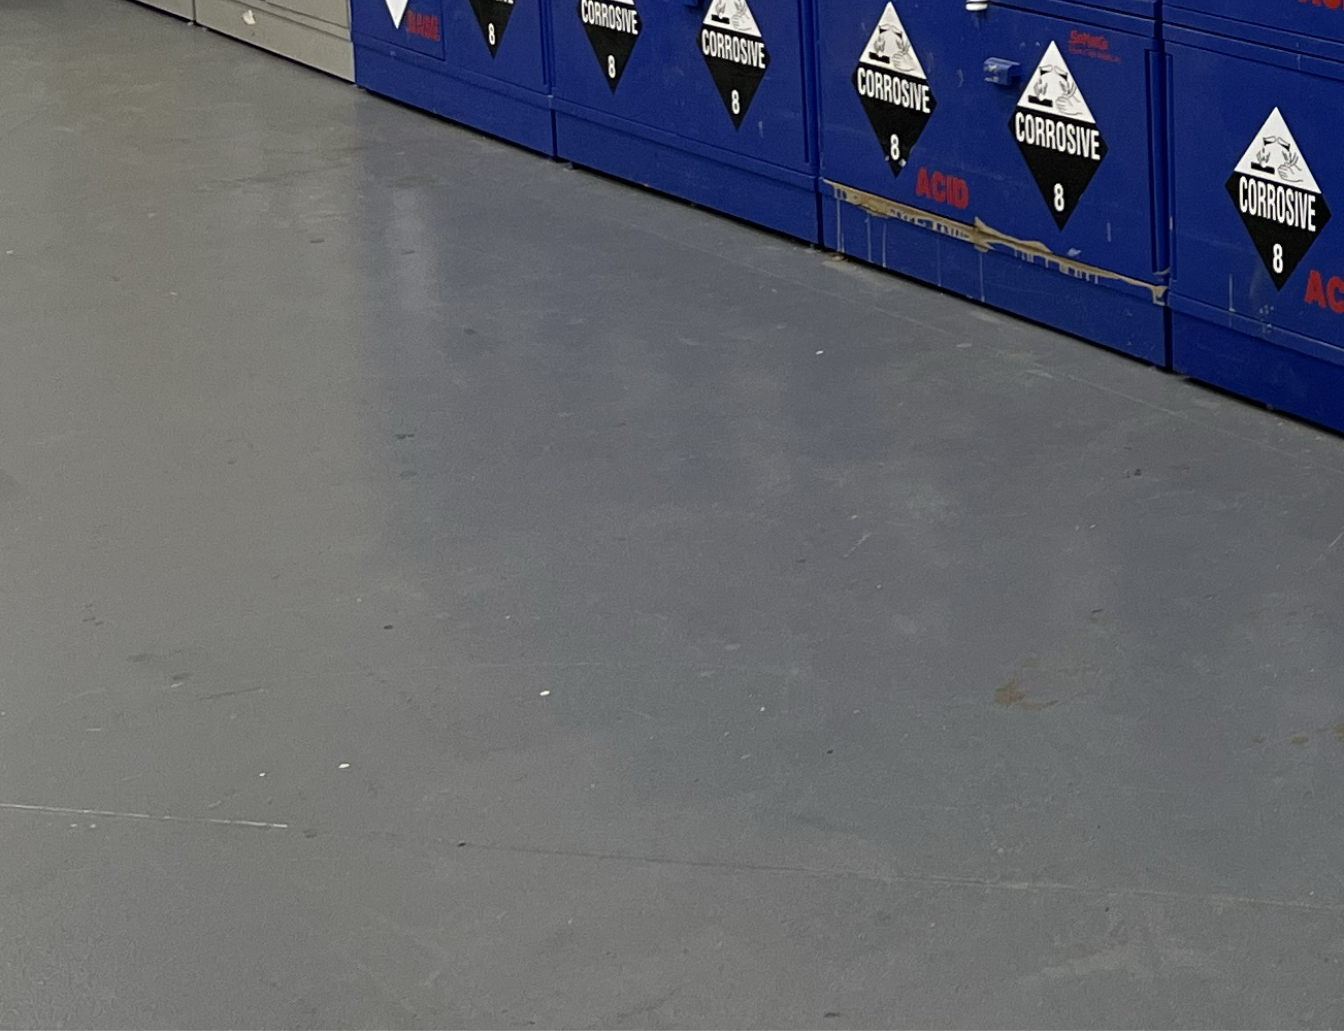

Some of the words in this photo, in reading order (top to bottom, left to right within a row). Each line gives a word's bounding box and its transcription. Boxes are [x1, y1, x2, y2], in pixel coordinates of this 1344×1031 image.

[488, 22, 496, 45] 8
[701, 28, 766, 69] CORROSIVE
[608, 54, 617, 78] 8
[731, 89, 740, 115] 8
[856, 67, 931, 114] CORROSIVE
[890, 133, 900, 161] 8
[1014, 111, 1101, 161] CORROSIVE
[915, 166, 970, 210] ACID
[1053, 183, 1065, 212] 8
[1238, 176, 1317, 233] CORROSIVE
[1272, 243, 1284, 274] 8
